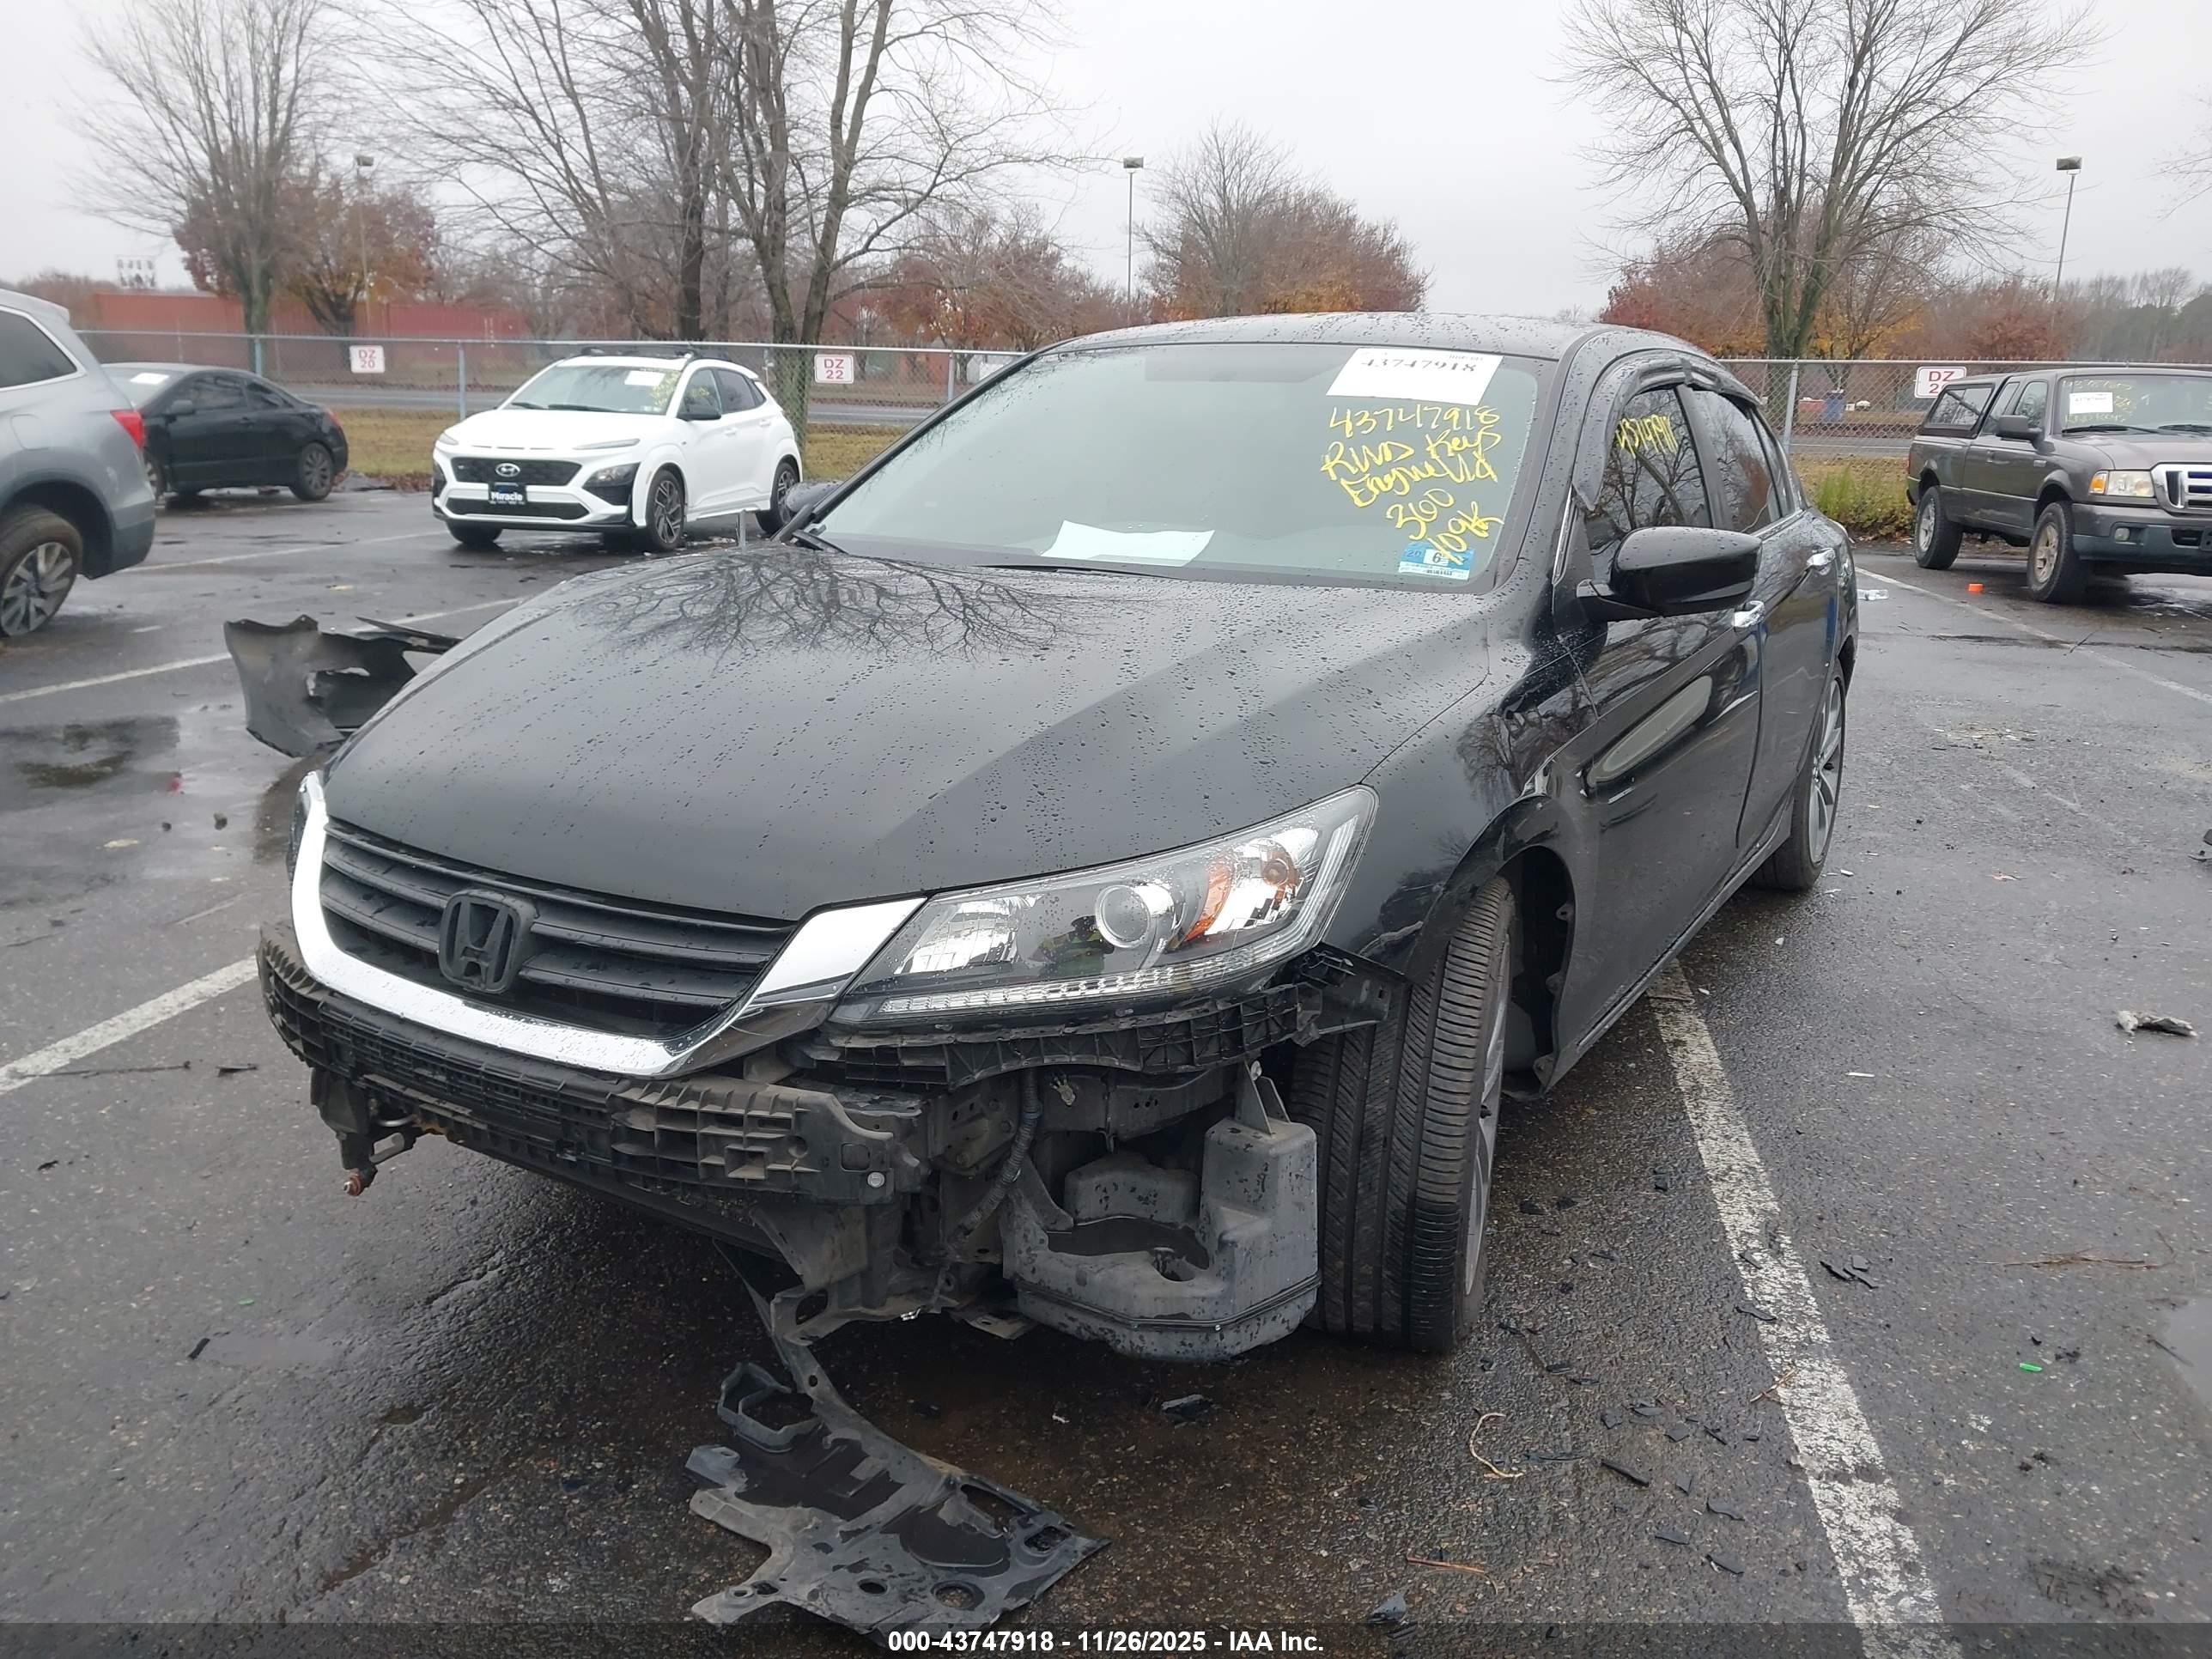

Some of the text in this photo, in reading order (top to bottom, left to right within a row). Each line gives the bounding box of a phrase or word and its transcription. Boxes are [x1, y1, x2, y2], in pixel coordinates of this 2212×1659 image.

[358, 349, 376, 359] DZ
[361, 360, 375, 368] 20
[823, 358, 845, 369] DZ
[825, 369, 844, 380] 22
[1929, 371, 1955, 382] DZ
[1329, 404, 1501, 439] 43747918
[1385, 488, 1455, 541] 360
[1432, 551, 1443, 564] 6
